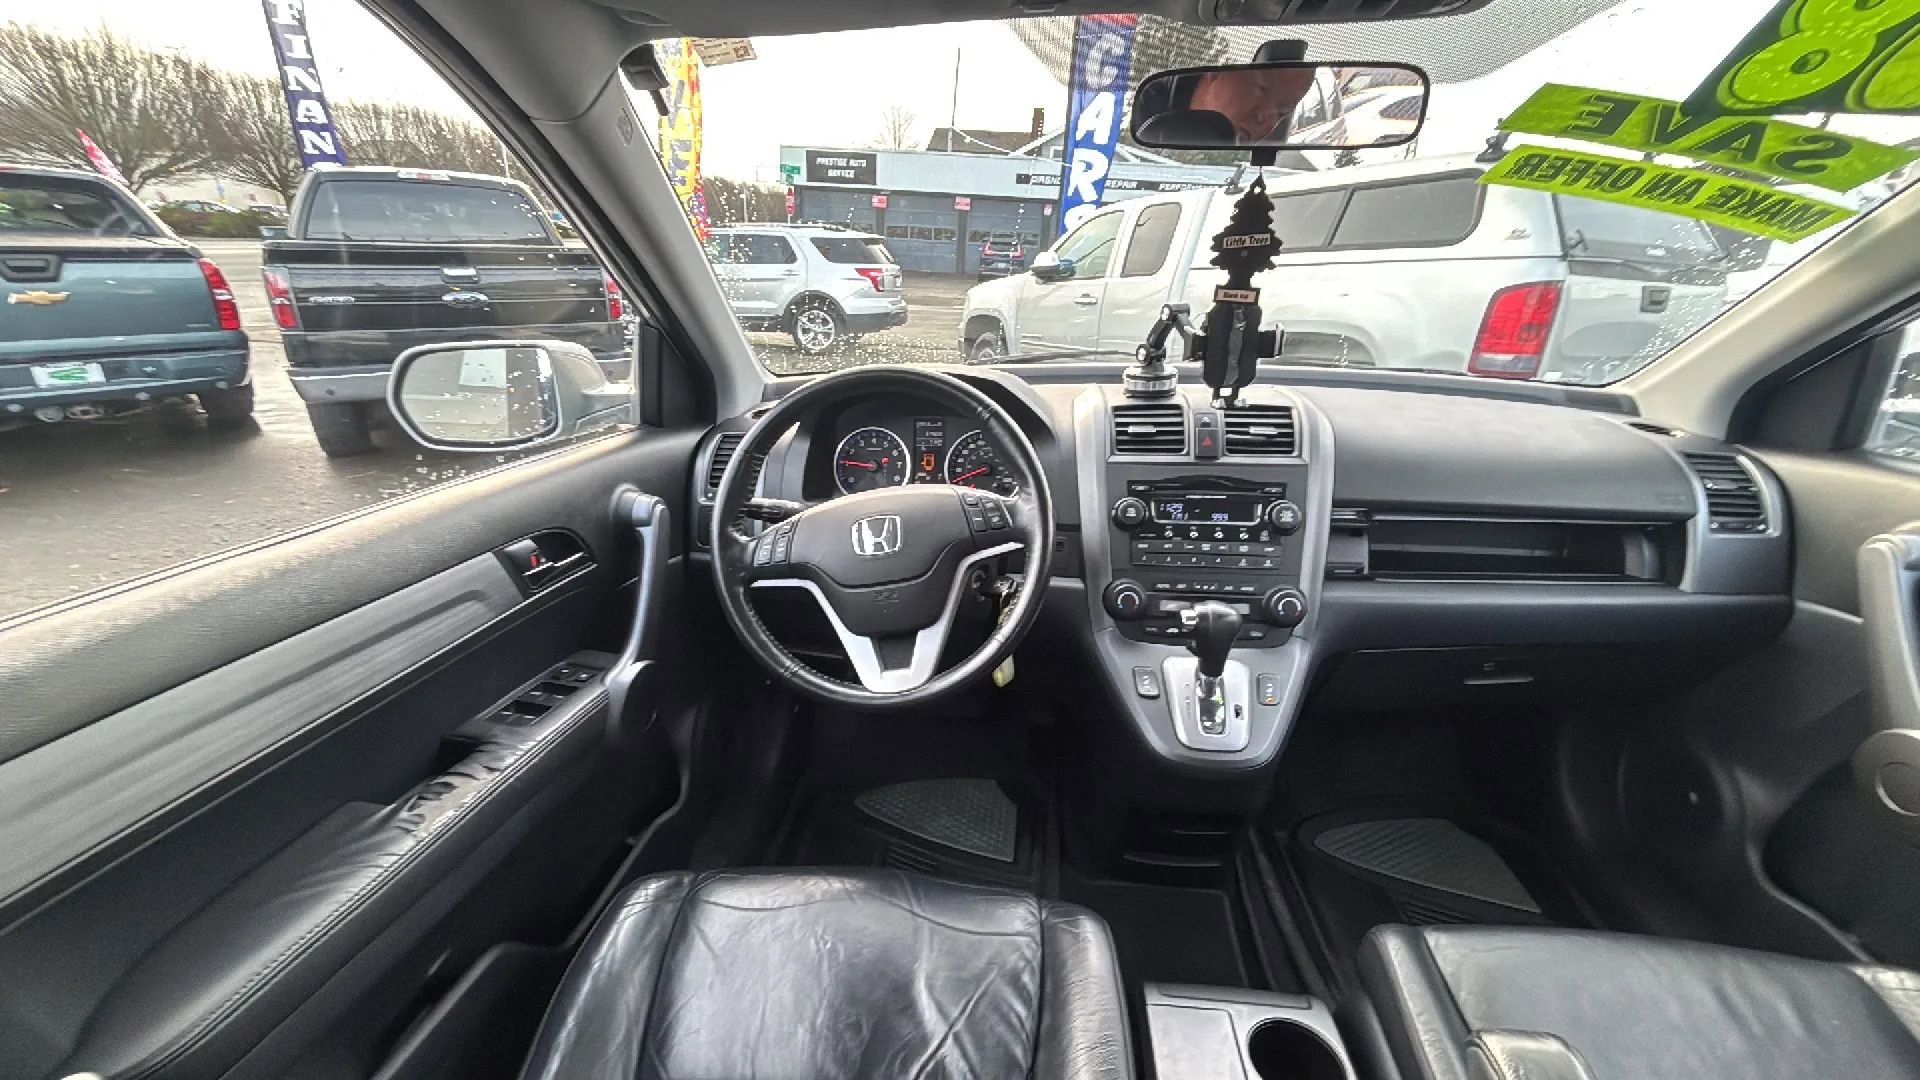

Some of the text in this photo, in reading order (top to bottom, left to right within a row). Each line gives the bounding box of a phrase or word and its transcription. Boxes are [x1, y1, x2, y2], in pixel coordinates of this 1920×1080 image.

[272, 0, 342, 169] FINAN
[816, 157, 867, 168] PRESTIGE AUTO
[827, 169, 855, 178] SERVICE
[1105, 179, 1138, 189] REPAIR
[1225, 235, 1269, 247] Little Trees
